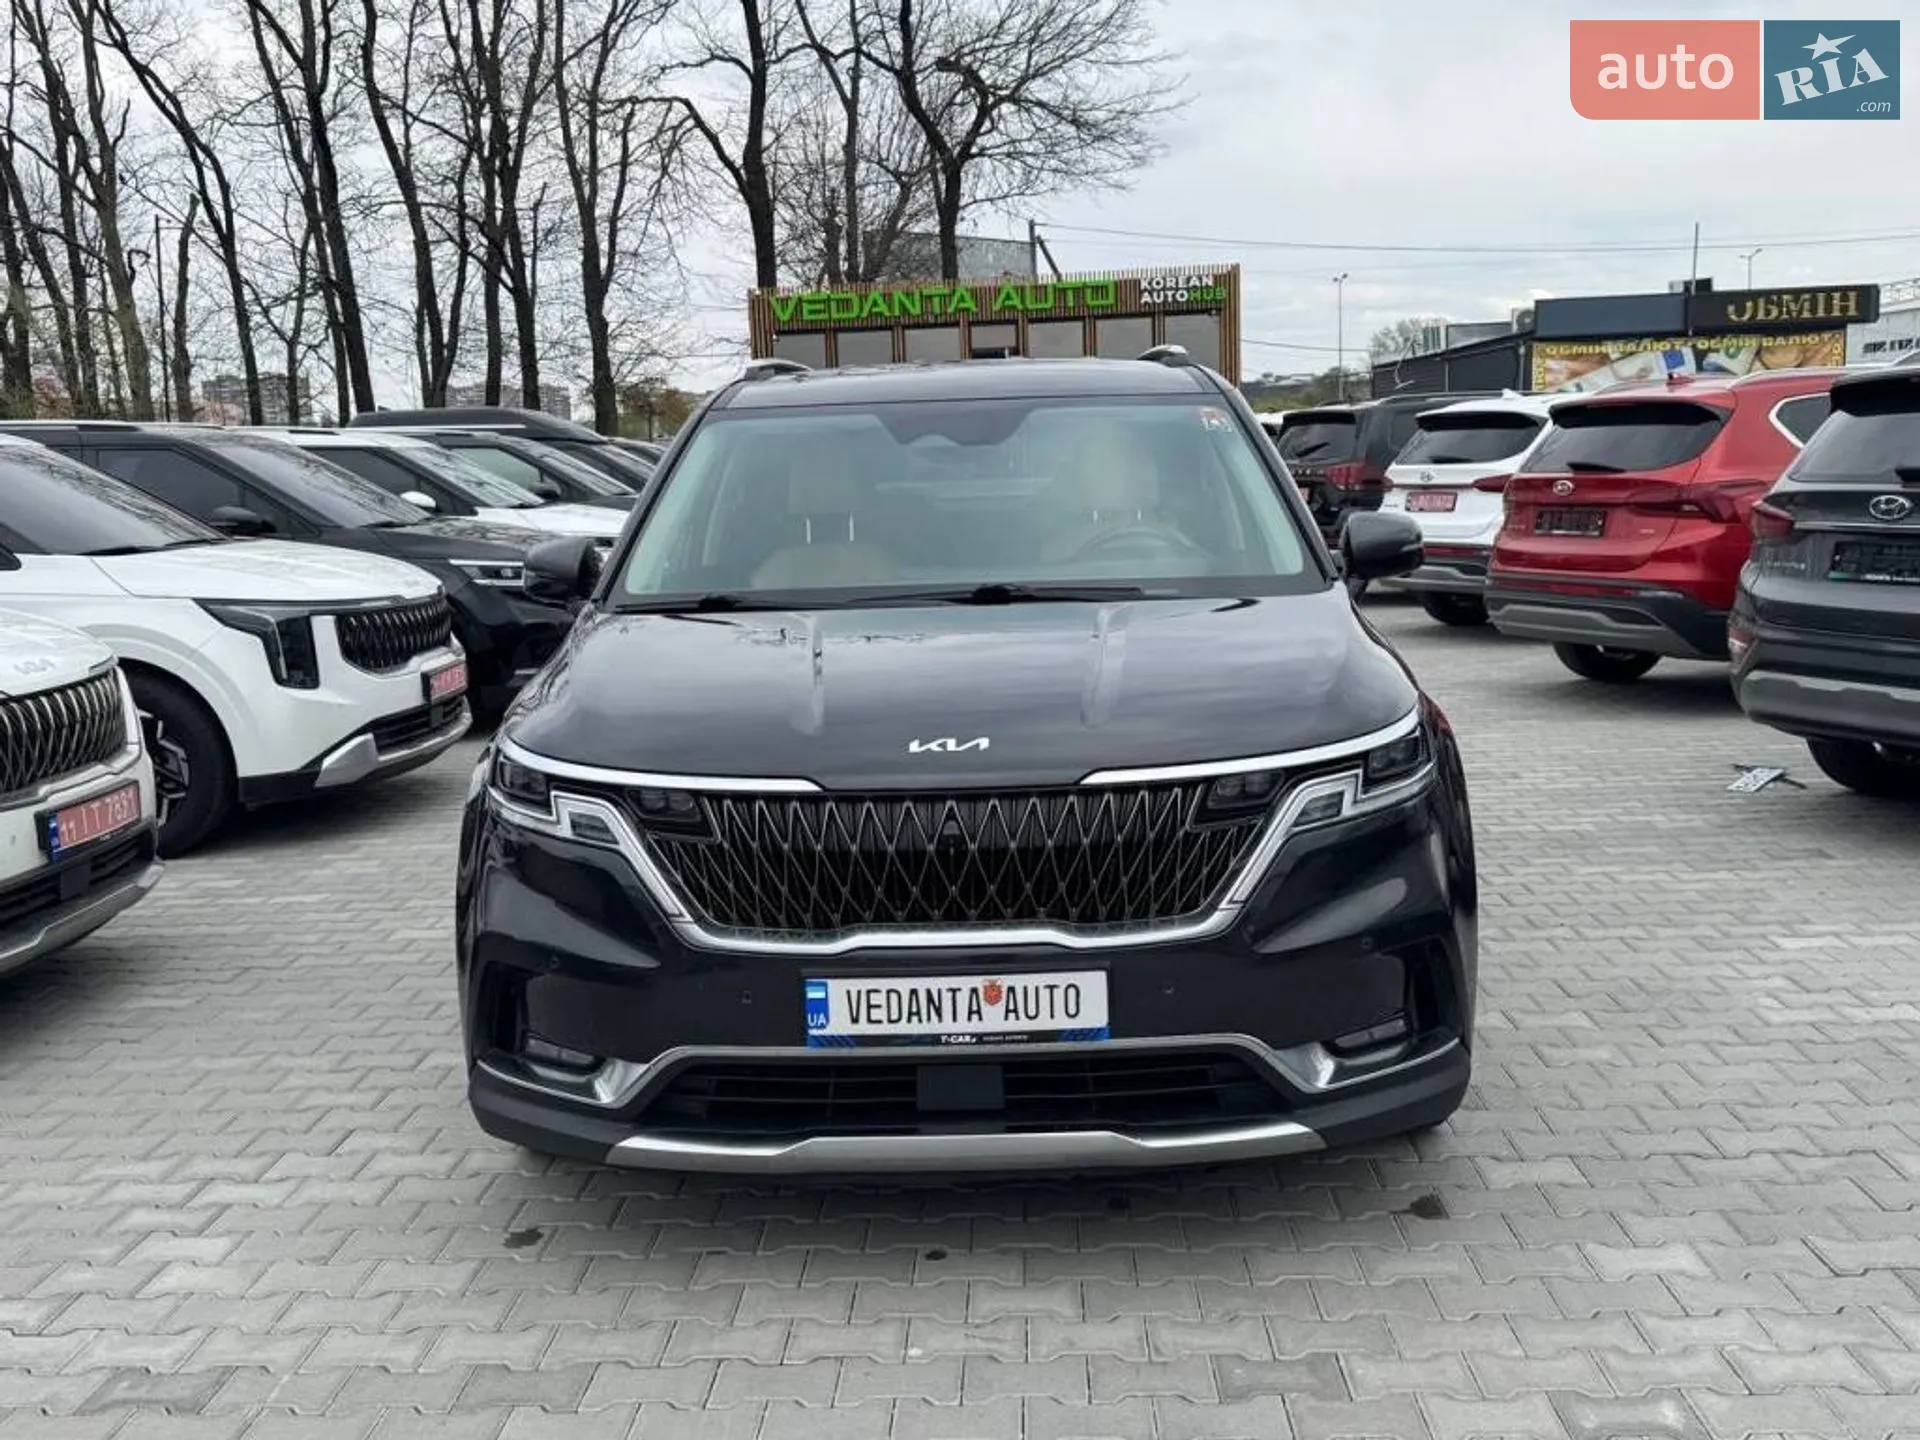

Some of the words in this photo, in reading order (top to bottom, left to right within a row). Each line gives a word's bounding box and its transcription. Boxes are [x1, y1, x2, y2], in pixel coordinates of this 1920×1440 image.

[1140, 275, 1213, 290] KOREAN
[770, 286, 976, 322] VEDANTA
[992, 278, 1117, 311] AUTO
[1727, 290, 1859, 322] ОБМІН
[807, 1012, 827, 1027] UA
[846, 986, 984, 1025] VEDANTA
[1003, 982, 1081, 1022] AUTO
